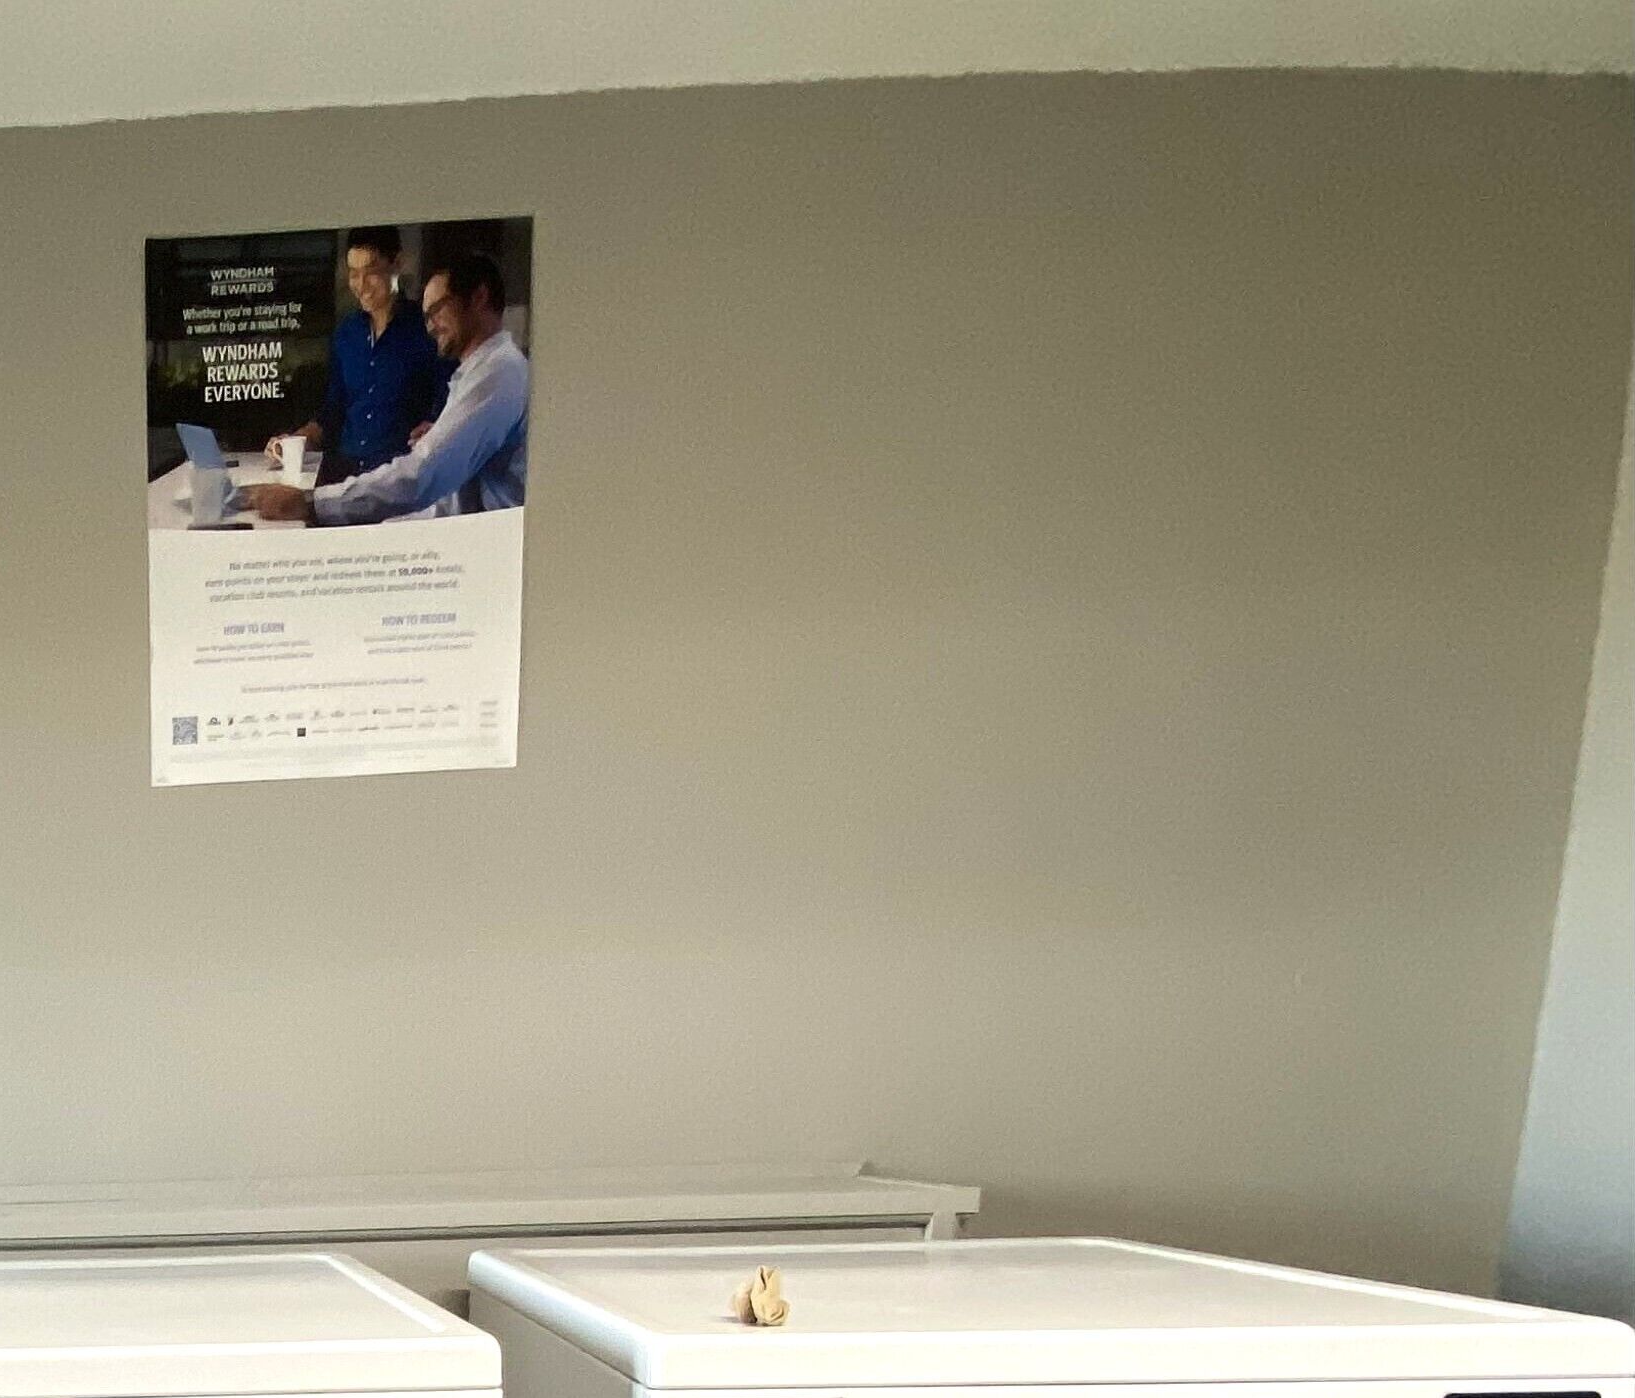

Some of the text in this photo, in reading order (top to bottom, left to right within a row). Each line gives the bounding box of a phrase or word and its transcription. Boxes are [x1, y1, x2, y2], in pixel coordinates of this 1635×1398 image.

[210, 267, 274, 280] WYNDHAM
[211, 282, 274, 296] REWARDS
[183, 307, 221, 320] Whether
[254, 304, 287, 317] staying
[186, 325, 193, 335] a
[195, 321, 217, 334] work
[219, 321, 236, 335] trip
[237, 322, 247, 332] or
[250, 321, 256, 331] a
[258, 318, 279, 330] road
[202, 341, 283, 363] WYNDHAM
[207, 362, 278, 383] REWARDS
[205, 381, 285, 403] EVERYONE.
[382, 616, 404, 626] HOW
[406, 615, 417, 625] TO
[224, 625, 245, 636] HOW
[248, 624, 259, 634] TO
